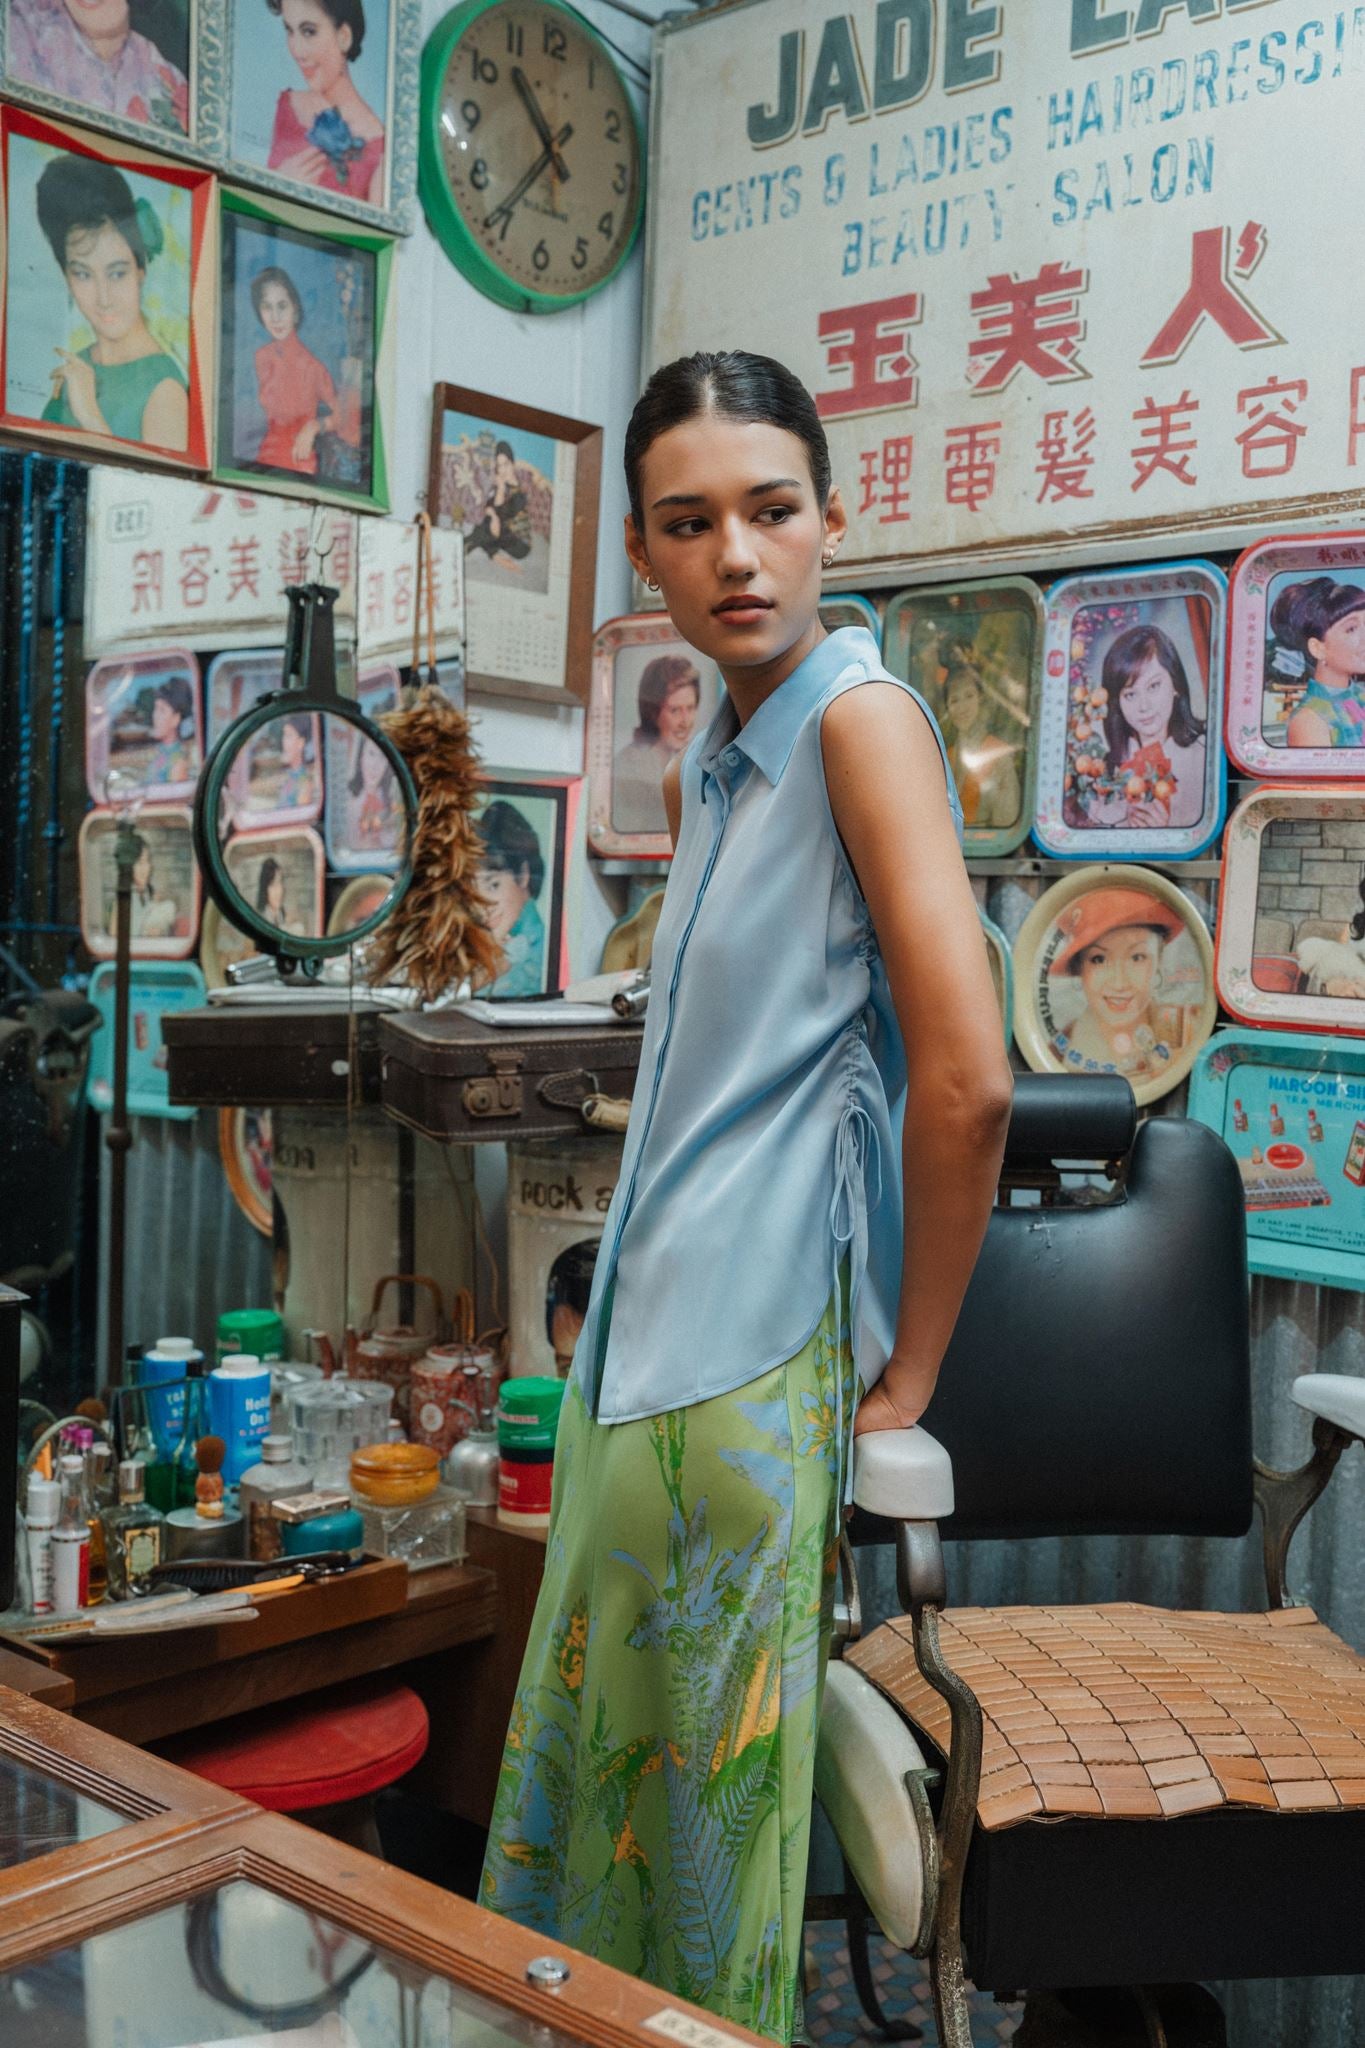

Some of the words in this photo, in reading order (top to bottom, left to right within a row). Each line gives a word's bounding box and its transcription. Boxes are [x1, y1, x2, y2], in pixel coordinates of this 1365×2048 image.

[507, 22, 524, 57] 11
[544, 21, 567, 61] 12
[471, 47, 498, 84] 10
[588, 58, 595, 90] 1
[747, 0, 1001, 148] JADE
[461, 100, 481, 133] 9
[605, 109, 621, 143] 2
[469, 158, 489, 191] 8
[612, 162, 628, 195] 3
[691, 164, 802, 241] GENTS
[869, 106, 1014, 198] LADIES
[841, 183, 1015, 278] BEAUTY
[1051, 136, 1215, 226] SALON
[597, 211, 613, 242] 4
[532, 239, 550, 271] 6
[571, 236, 588, 270] 5
[814, 219, 1276, 420] 玉美人
[857, 366, 1365, 526] 理電髮美容
